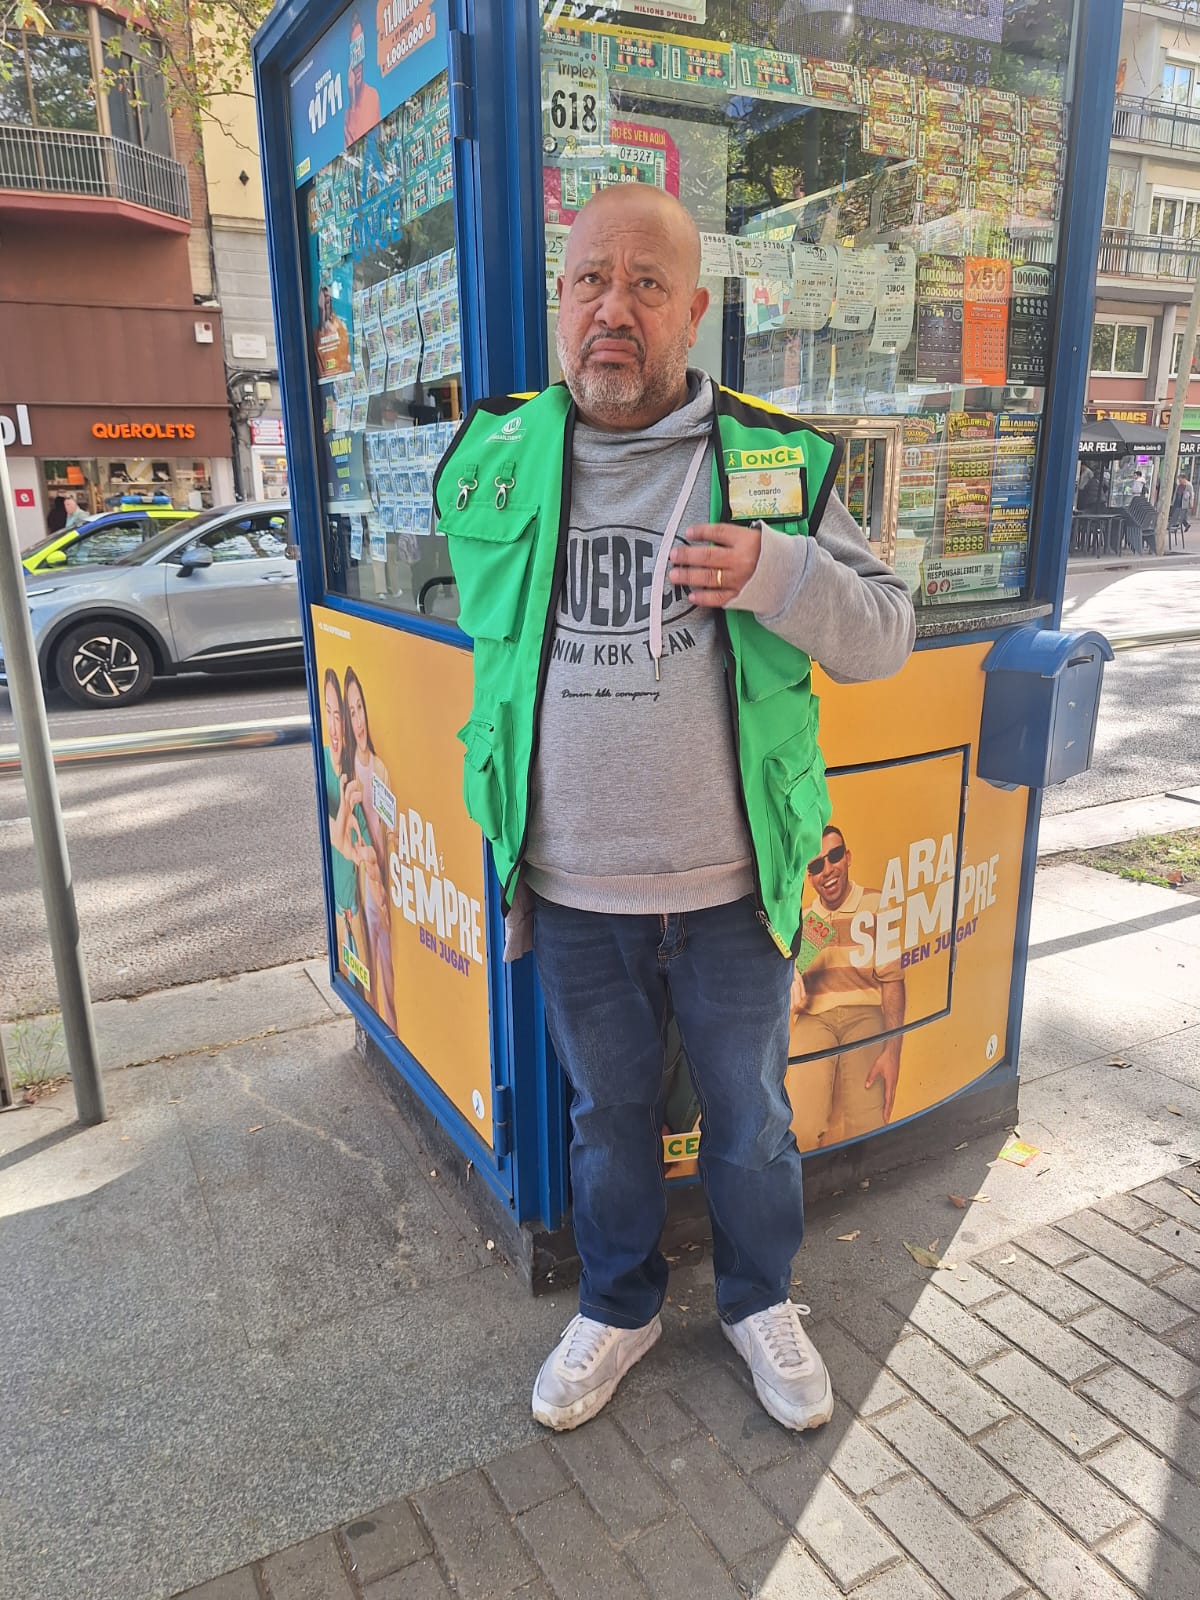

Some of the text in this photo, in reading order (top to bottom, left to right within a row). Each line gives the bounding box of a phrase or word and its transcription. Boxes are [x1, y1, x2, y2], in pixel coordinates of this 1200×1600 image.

[634, 5, 698, 22] MILIONS D'EUROS
[551, 90, 597, 133] 618
[620, 147, 652, 162] 07327
[1109, 411, 1148, 423] TABACS
[92, 423, 195, 439] QUEROLETS
[1079, 442, 1117, 452] BAR FELIZ
[1180, 443, 1195, 452] BAR
[745, 450, 798, 465] ONCE
[749, 487, 781, 497] Leonardo
[927, 562, 942, 572] JUGA
[927, 565, 982, 580] RESPONSABLEMENT
[594, 644, 634, 666] KBK
[562, 688, 592, 699] Denim
[615, 690, 660, 701] company
[398, 808, 440, 876] ARA
[880, 832, 957, 909] ARA
[389, 851, 482, 965] SEMPRE
[850, 853, 999, 969] SEMPRE
[419, 926, 470, 977] BEN JUGAT
[901, 917, 979, 970] BEN JUGAT
[350, 947, 368, 986] ONCE
